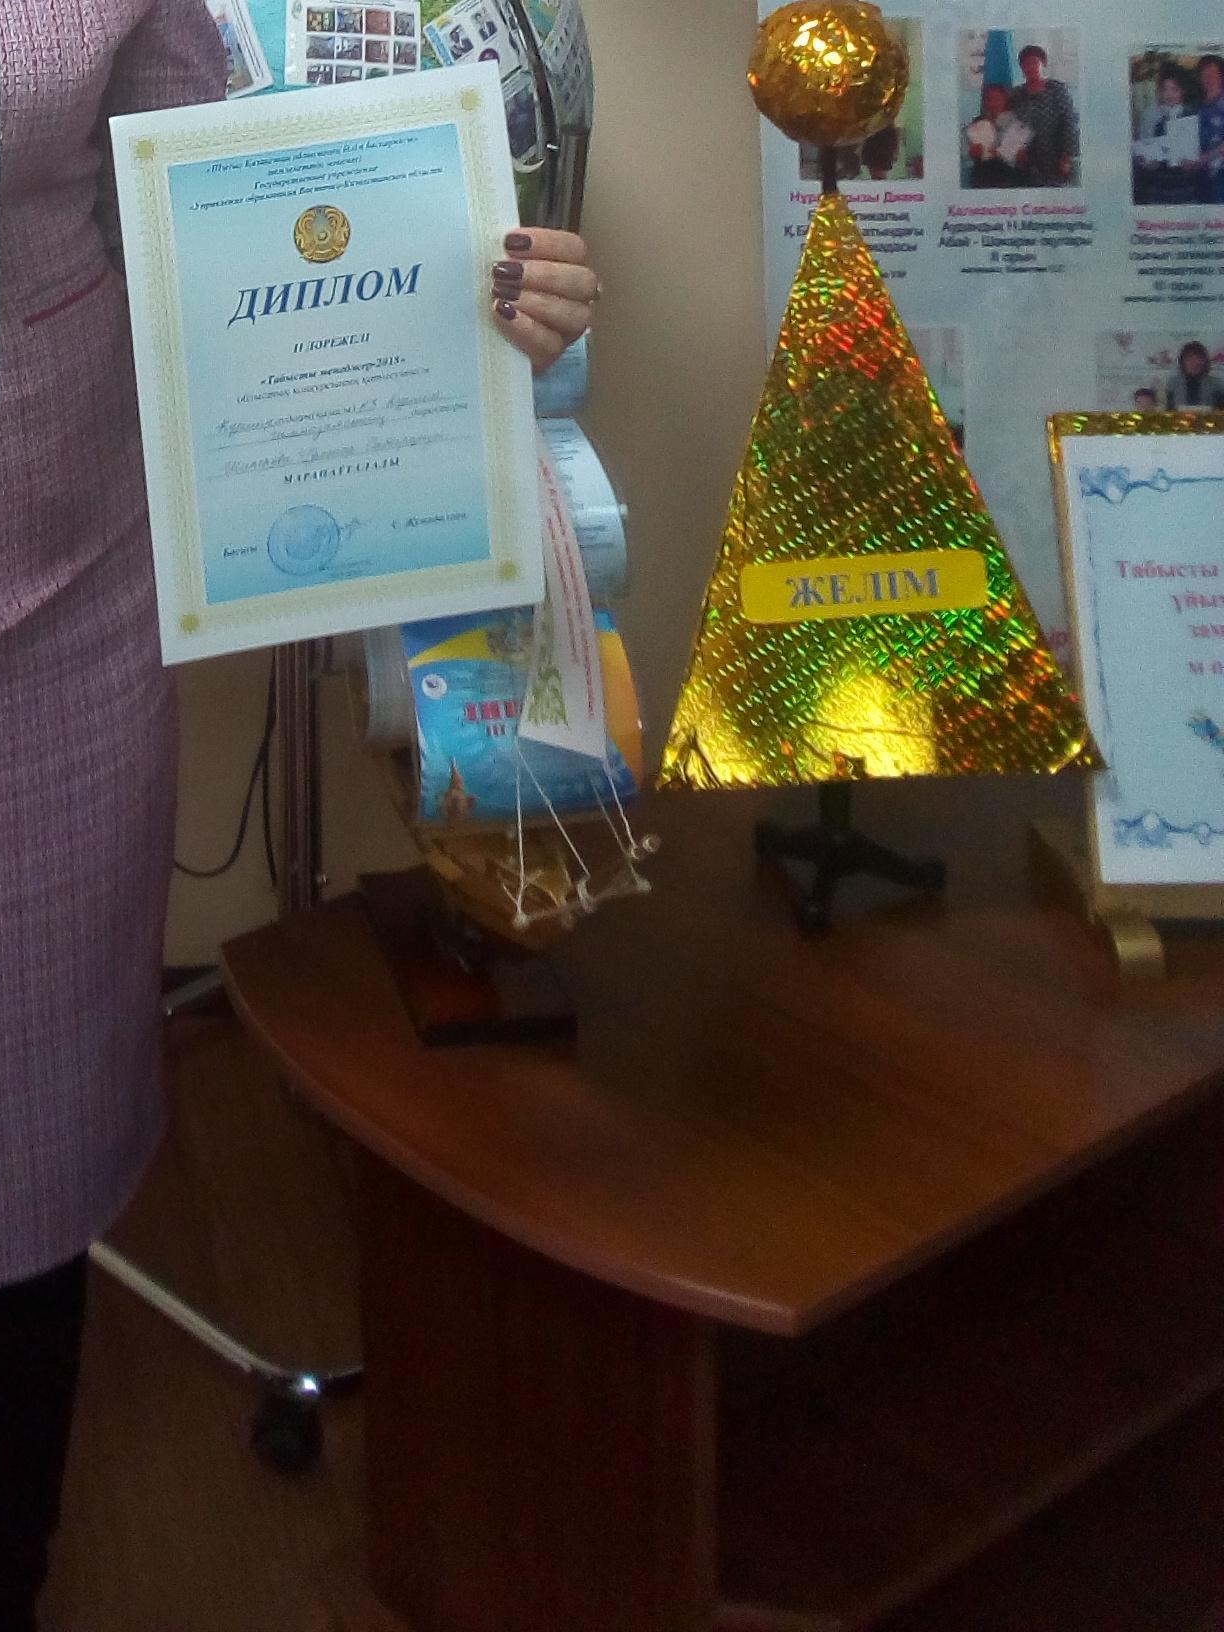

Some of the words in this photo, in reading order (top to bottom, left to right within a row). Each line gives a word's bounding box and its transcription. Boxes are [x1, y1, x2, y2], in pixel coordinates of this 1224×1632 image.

[226, 263, 423, 330] ДИПЛОМ
[785, 567, 940, 609] ЖЕЛІМ
[1116, 559, 1219, 579] Табысты
